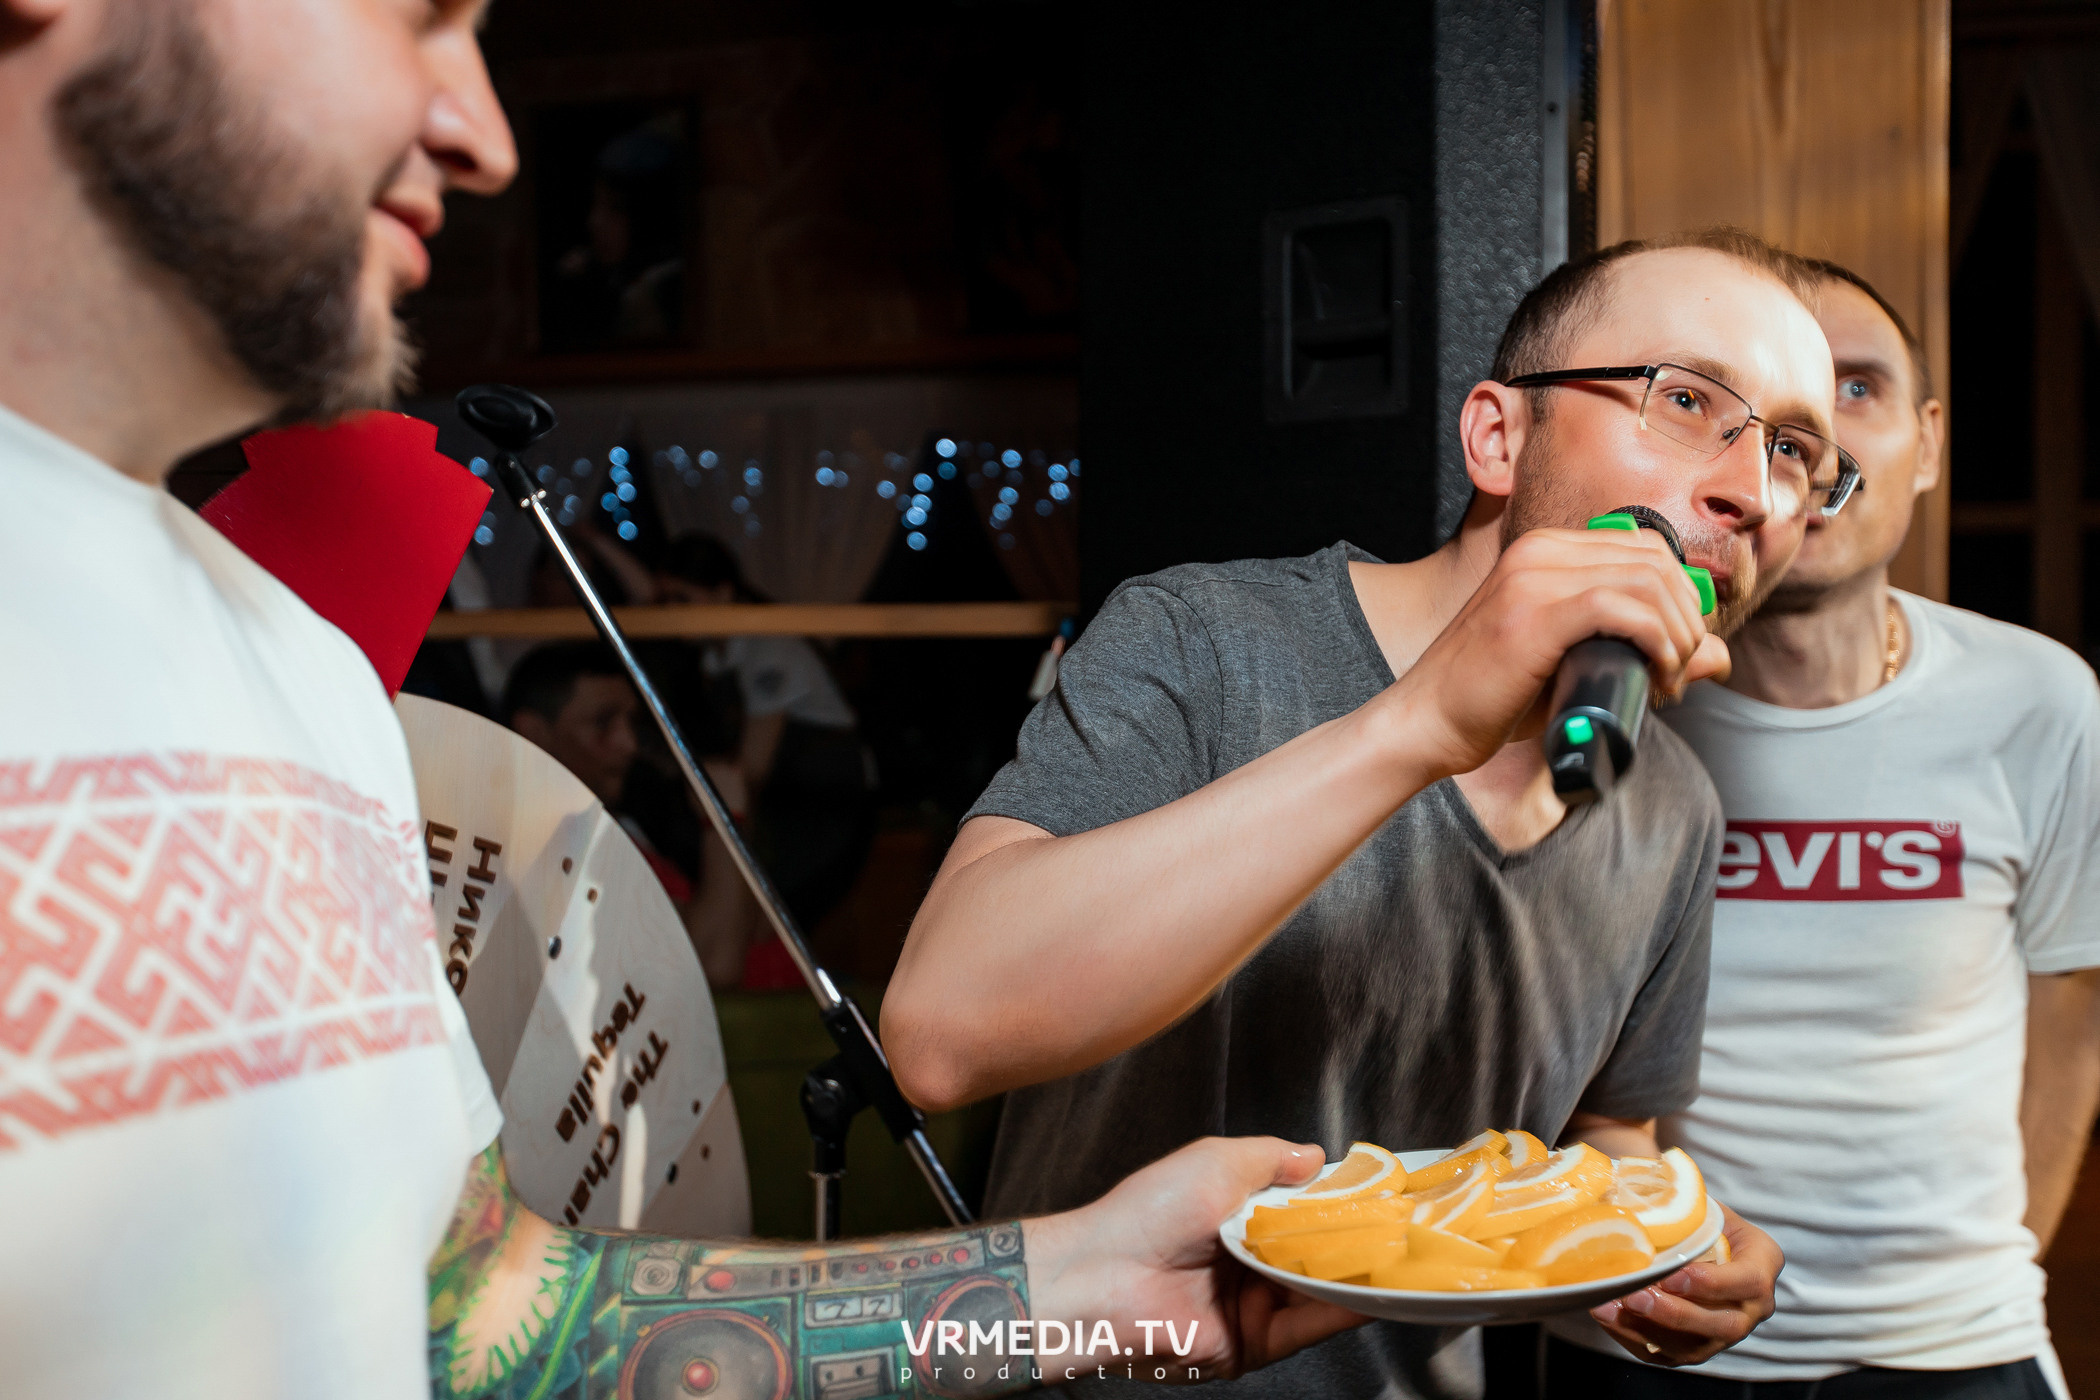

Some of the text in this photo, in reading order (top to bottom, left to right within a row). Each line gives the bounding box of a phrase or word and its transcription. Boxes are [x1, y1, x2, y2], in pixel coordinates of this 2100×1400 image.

[1714, 829, 1942, 891] eVI'S
[555, 981, 646, 1143] Tequila
[620, 1030, 669, 1110] The
